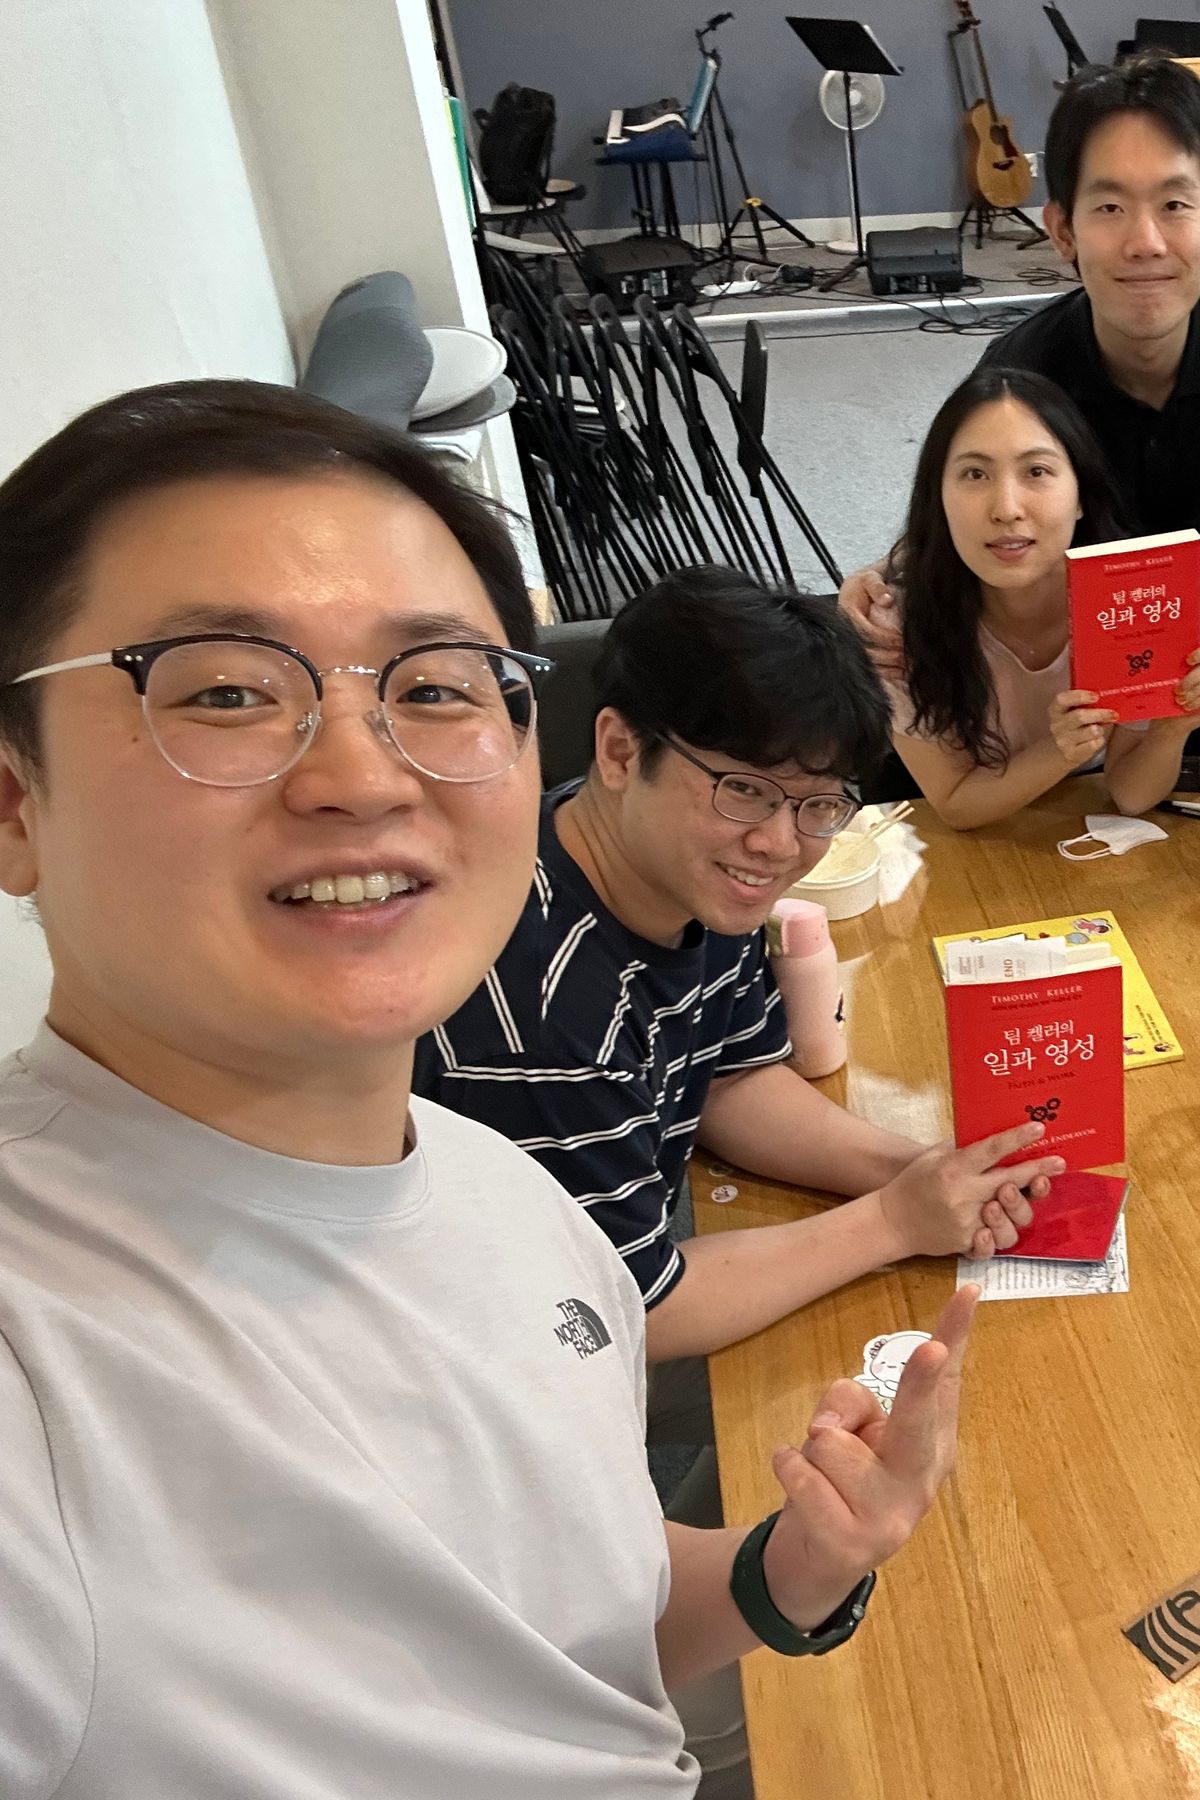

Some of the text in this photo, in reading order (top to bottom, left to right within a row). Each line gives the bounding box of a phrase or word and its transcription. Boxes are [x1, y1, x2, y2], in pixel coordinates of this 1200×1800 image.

[1112, 584, 1166, 605] 팀 켈러의
[1097, 597, 1180, 630] 일과 영성
[991, 992, 1040, 1005] TIMOTHY
[1046, 985, 1084, 998] KELLER
[1004, 1019, 1074, 1046] 팀 켈러의
[983, 1034, 1094, 1076] 일과 영성
[556, 1299, 581, 1321] THE
[553, 1316, 591, 1346] NORTH
[572, 1333, 598, 1360] FACE
